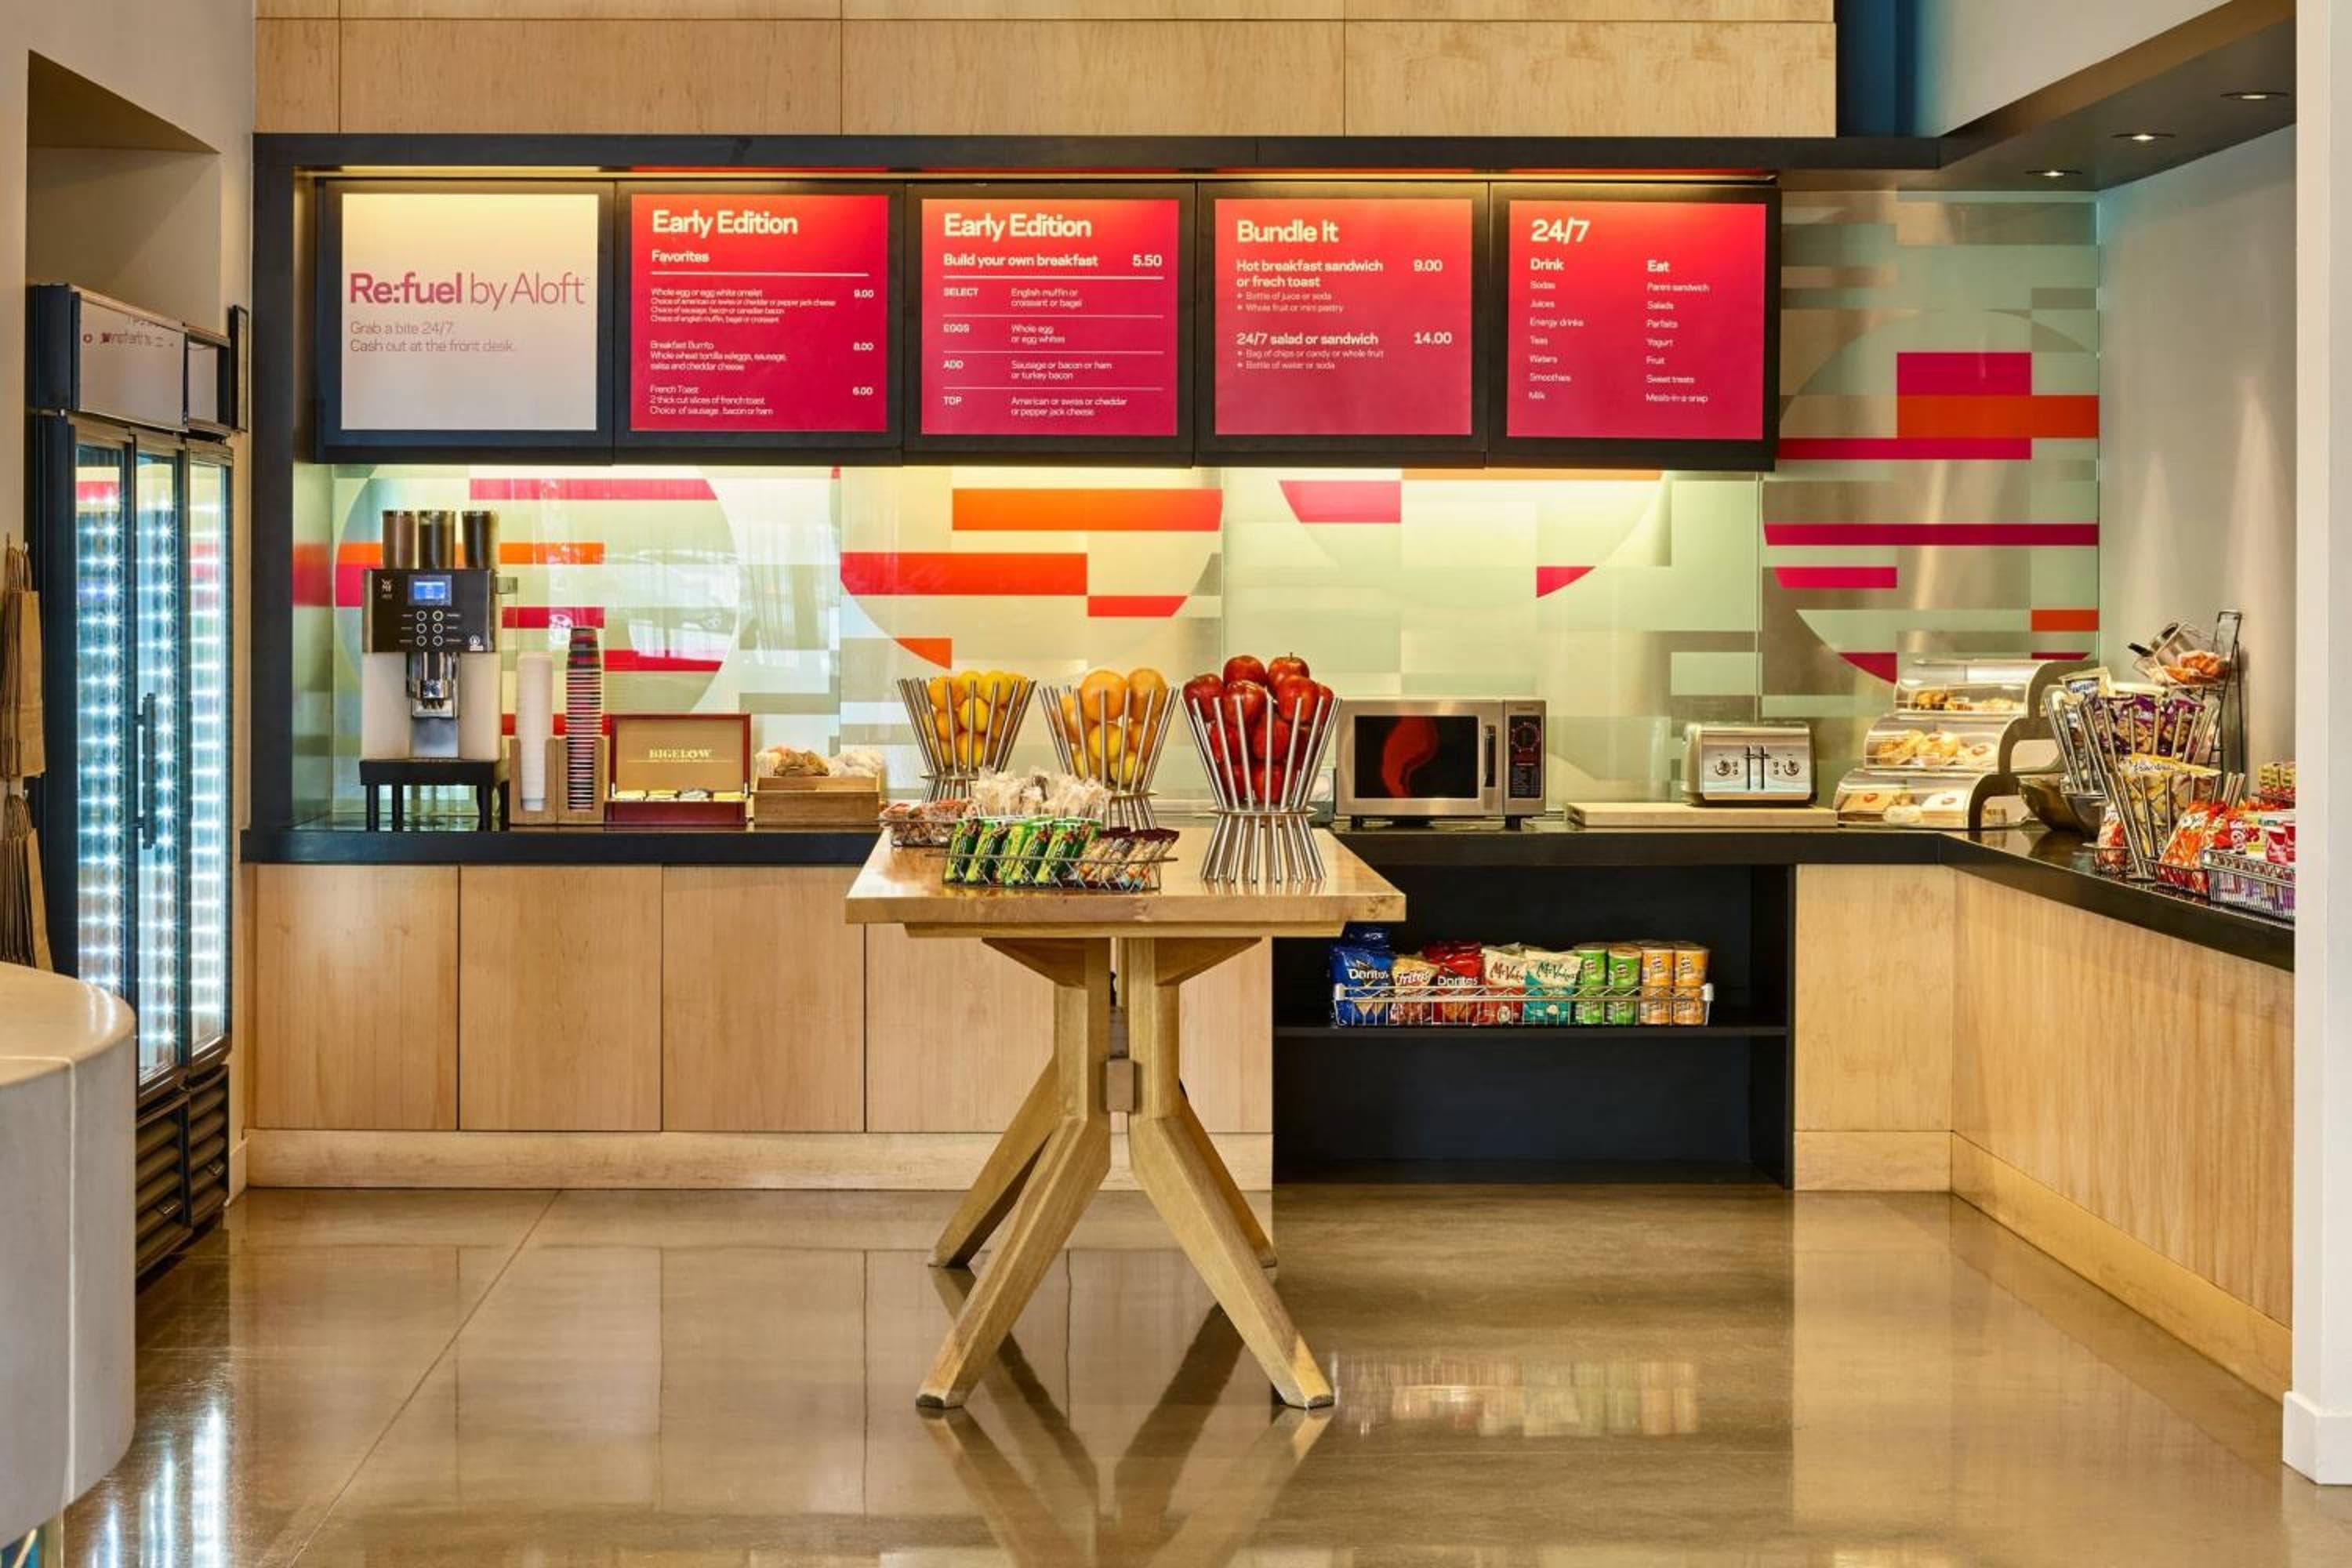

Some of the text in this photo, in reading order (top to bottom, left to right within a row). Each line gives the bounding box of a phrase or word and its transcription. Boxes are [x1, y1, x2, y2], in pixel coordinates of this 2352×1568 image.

[652, 209, 798, 238] Early Edition
[944, 212, 1092, 241] Early Edition
[1236, 220, 1339, 242] Bundle It
[1531, 217, 1590, 244] 24/7
[652, 251, 709, 263] Favorites
[943, 253, 976, 267] Build
[1036, 255, 1098, 267] breakfast
[1133, 254, 1162, 267] 5.50
[1236, 260, 1260, 272] Hot
[1414, 260, 1443, 272] 9.00
[1530, 258, 1563, 270] Drink
[1647, 260, 1669, 273] Eat
[350, 272, 585, 311] Re:fuel by Aloft
[854, 289, 873, 298] 9.00
[350, 321, 382, 334] Grab
[395, 321, 419, 334] bite
[1236, 332, 1267, 345] 24/7
[1414, 332, 1452, 344] 14.00
[350, 339, 383, 352] Cash
[426, 339, 446, 352] the
[449, 339, 480, 352] front
[1245, 348, 1262, 360] Bag
[649, 749, 712, 760] BIGELOW
[1348, 968, 1389, 980] Doritos
[1437, 975, 1479, 986] Doritos
